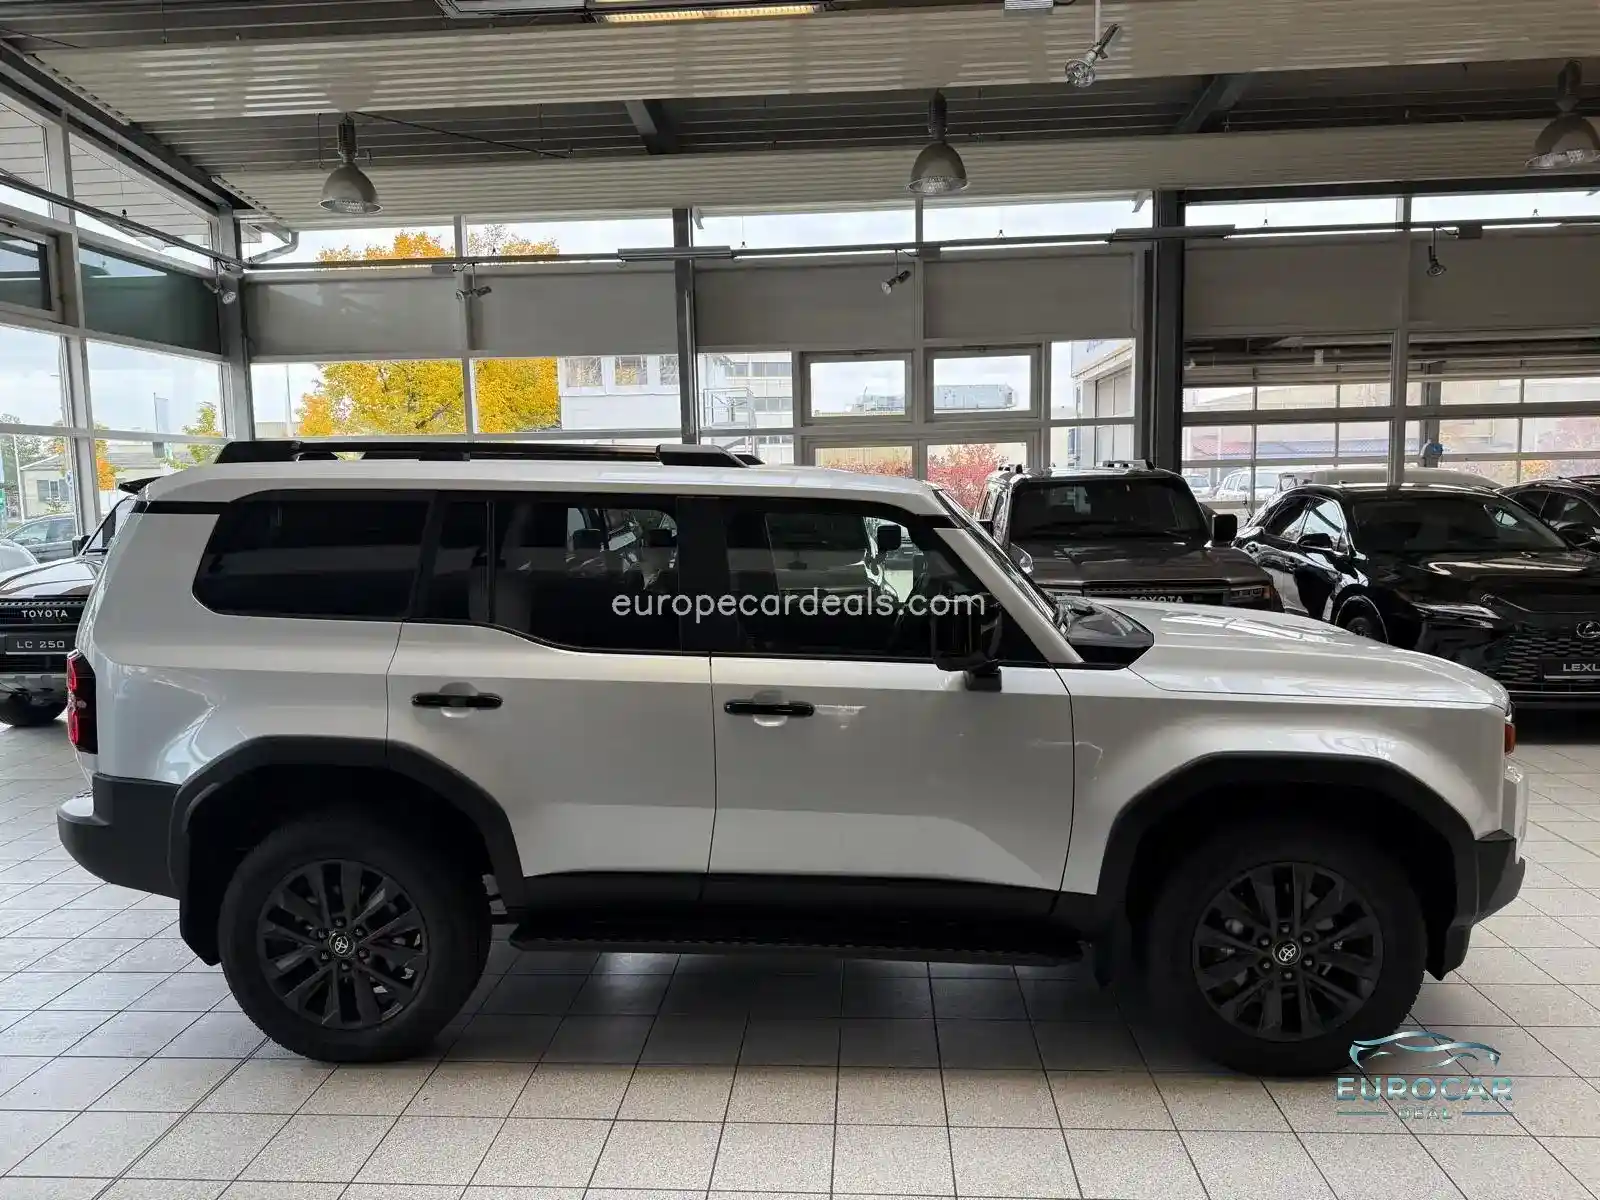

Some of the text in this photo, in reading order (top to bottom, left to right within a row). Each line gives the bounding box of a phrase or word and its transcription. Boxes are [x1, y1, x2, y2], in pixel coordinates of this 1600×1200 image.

[21, 609, 68, 618] TOYOTA
[16, 640, 65, 649] LC 250
[1562, 663, 1600, 672] LEXU
